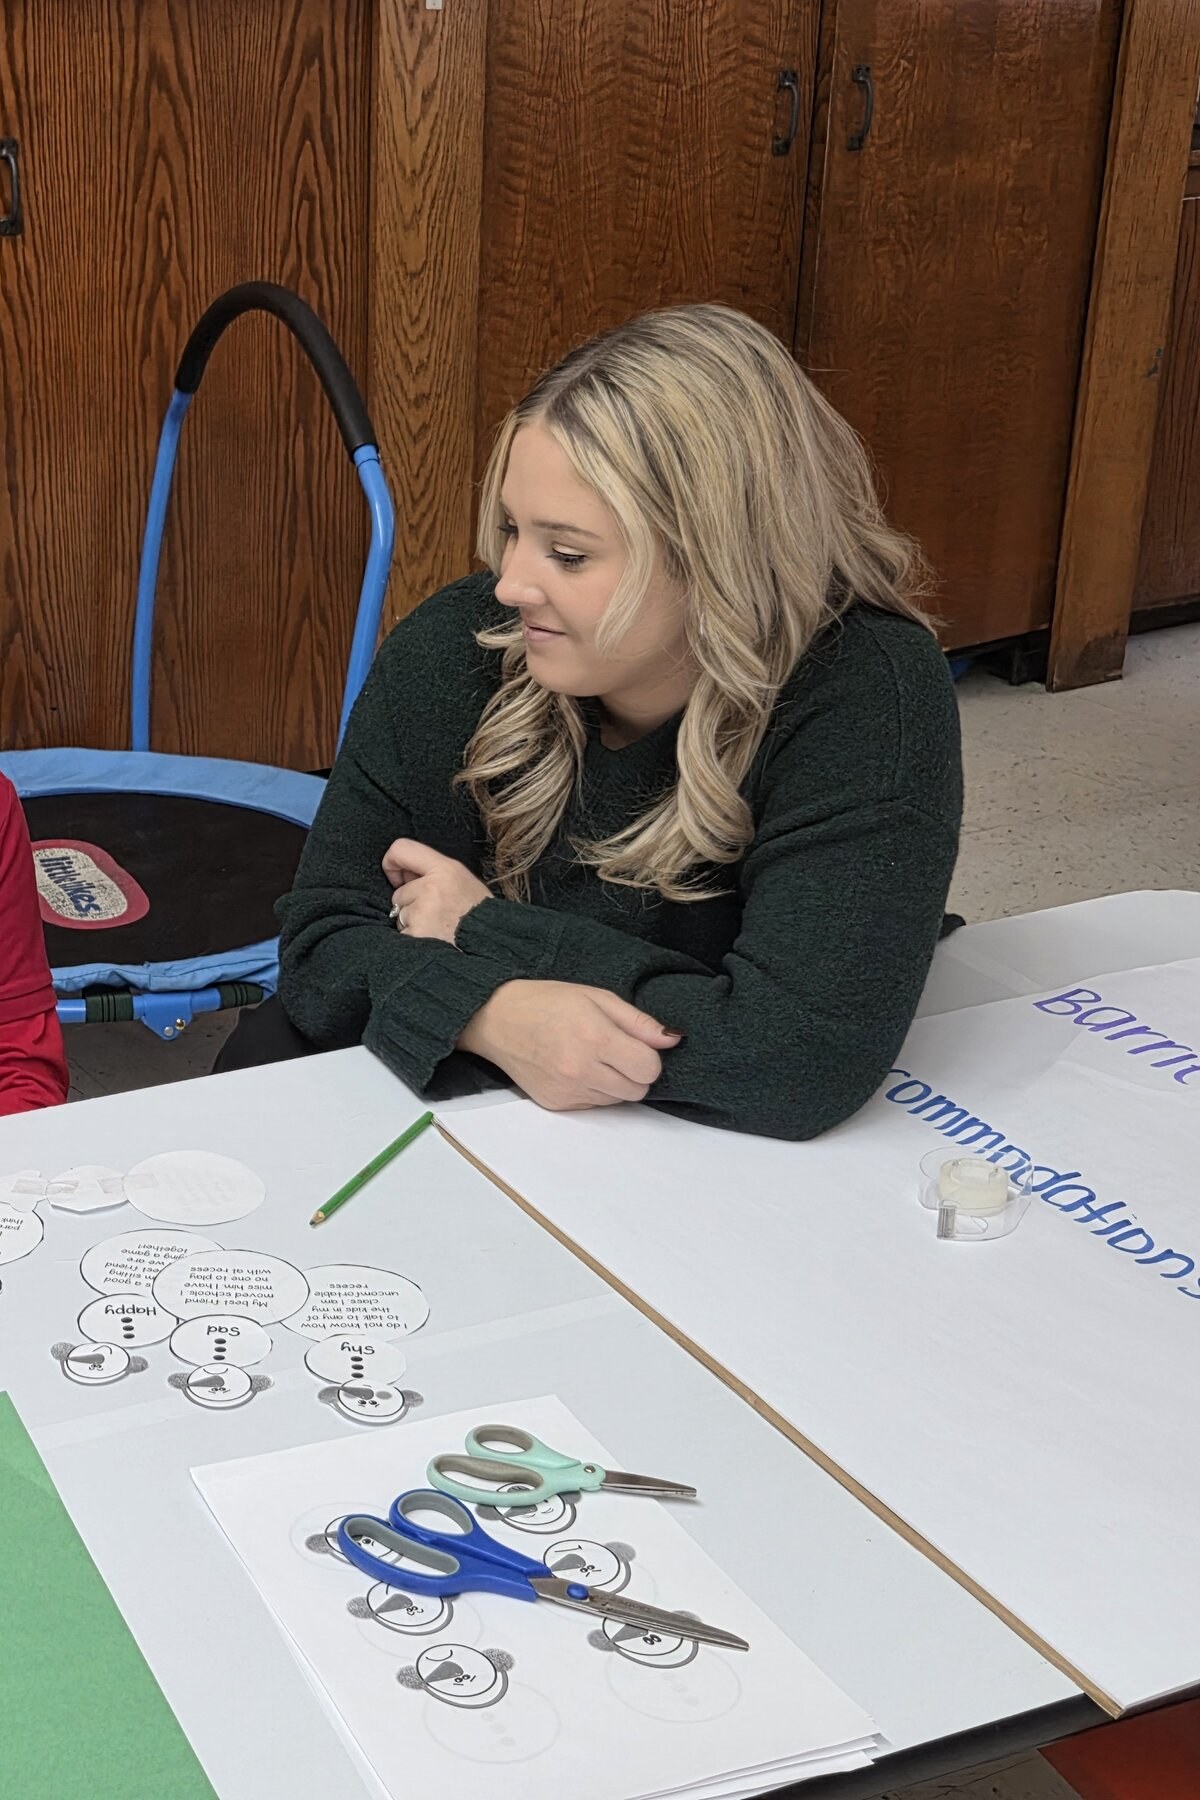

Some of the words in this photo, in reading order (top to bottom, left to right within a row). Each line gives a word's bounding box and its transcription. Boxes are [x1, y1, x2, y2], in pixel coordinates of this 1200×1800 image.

[885, 1069, 1200, 1299] ommodation
[1, 1217, 24, 1225] think
[121, 1249, 151, 1257] game
[138, 1244, 188, 1253] together!
[104, 1261, 139, 1272] friend
[108, 1269, 142, 1279] sitting
[189, 1273, 213, 1281] play
[103, 1276, 133, 1285] good
[224, 1299, 249, 1307] best
[252, 1299, 268, 1307] My
[104, 1304, 157, 1316] Happy
[311, 1305, 330, 1313] my
[206, 1325, 241, 1337] Sad
[340, 1341, 375, 1355] Shy
